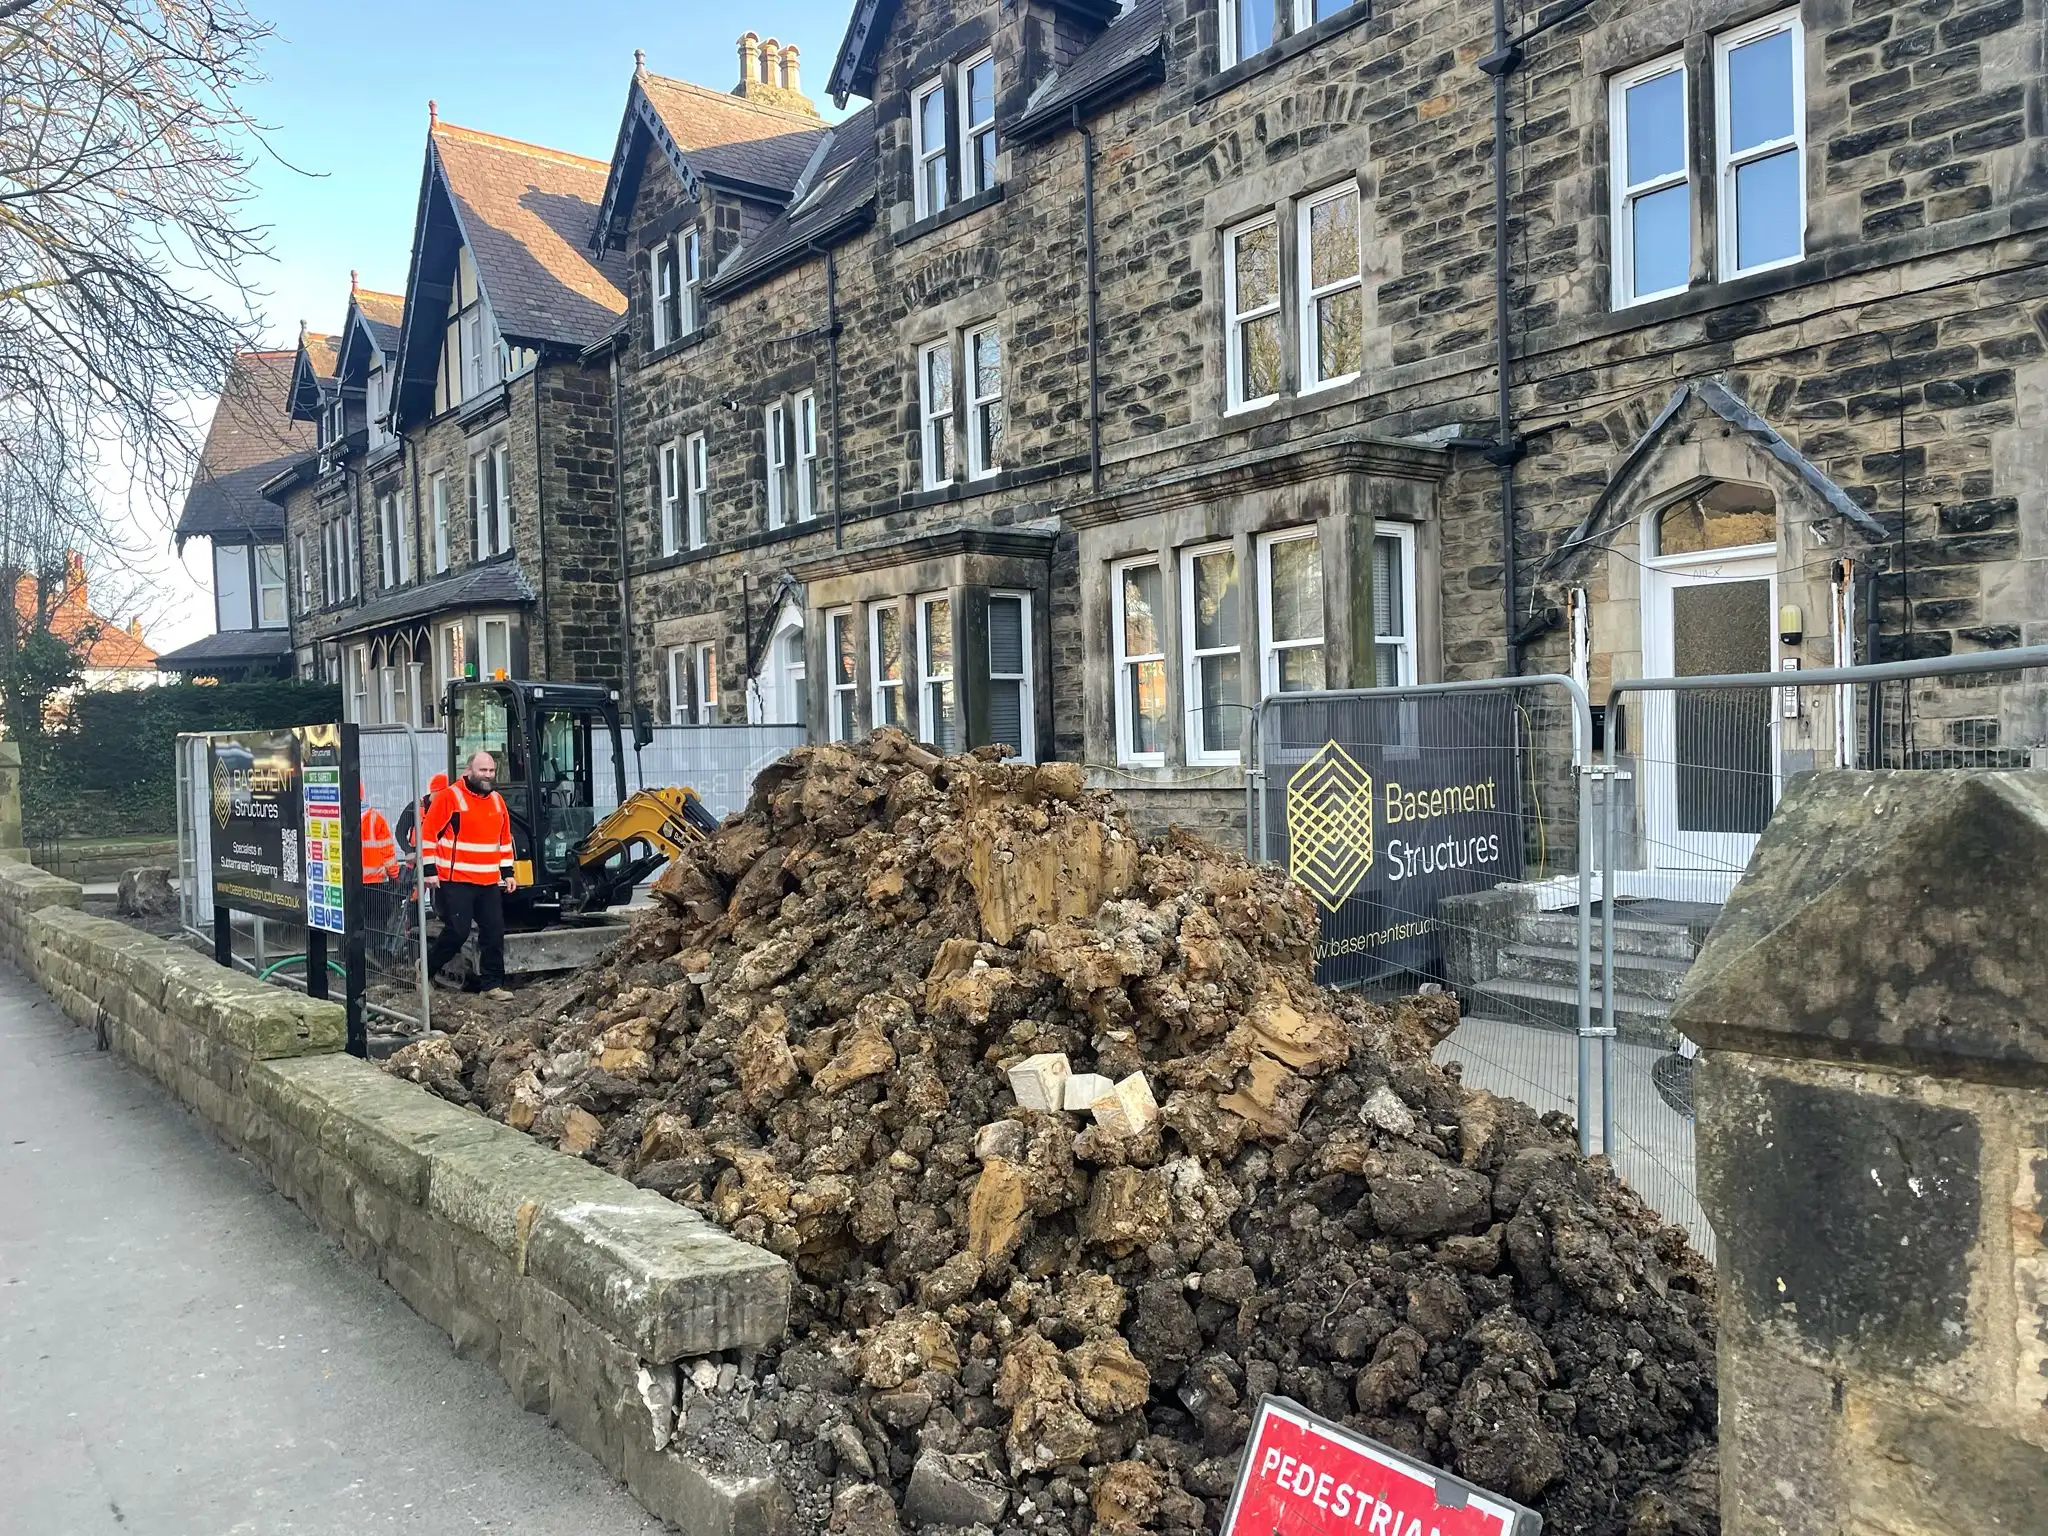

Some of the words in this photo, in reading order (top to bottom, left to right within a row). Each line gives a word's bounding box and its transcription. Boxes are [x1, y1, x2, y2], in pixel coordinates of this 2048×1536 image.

[233, 767, 294, 793] BASEMENT
[234, 798, 279, 818] Structures
[1386, 776, 1496, 824] Basement
[232, 841, 257, 856] Specialists
[257, 845, 263, 856] in
[1387, 834, 1499, 881] Structures
[220, 856, 250, 872] Subterranean
[250, 860, 278, 879] Engineering
[216, 882, 300, 908] www.basementstructures.co.uk
